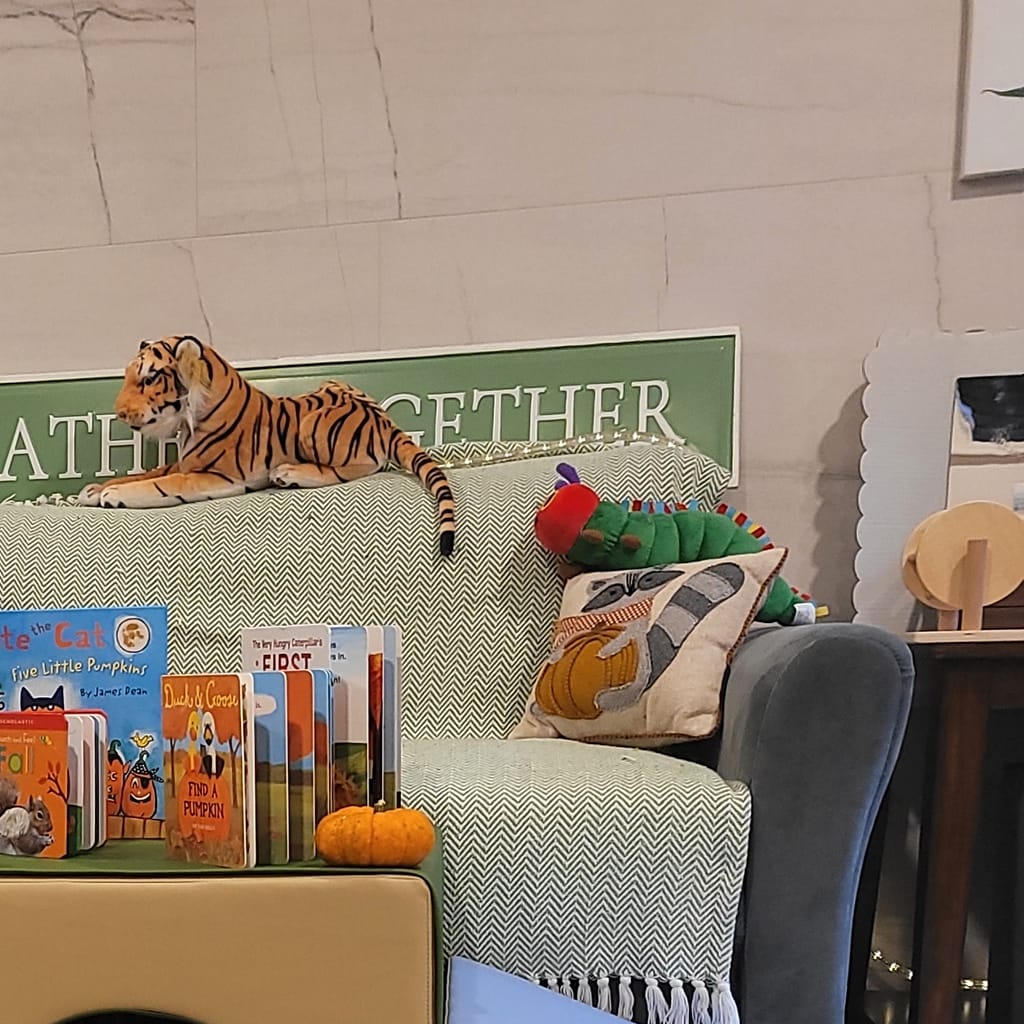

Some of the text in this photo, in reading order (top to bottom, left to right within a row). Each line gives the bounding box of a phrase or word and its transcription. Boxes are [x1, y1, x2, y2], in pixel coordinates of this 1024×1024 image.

[379, 379, 687, 448] GETHER
[31, 621, 52, 637] the
[54, 621, 106, 649] Cat
[273, 639, 291, 651] Hungry
[12, 657, 148, 682] Five Little Pumpkins
[262, 652, 312, 671] FIRST
[79, 686, 148, 698] By James Dean
[164, 683, 193, 709] Duck
[205, 680, 239, 709] Goose
[188, 781, 218, 798] FIND A
[183, 800, 225, 819] PUMPKIN
